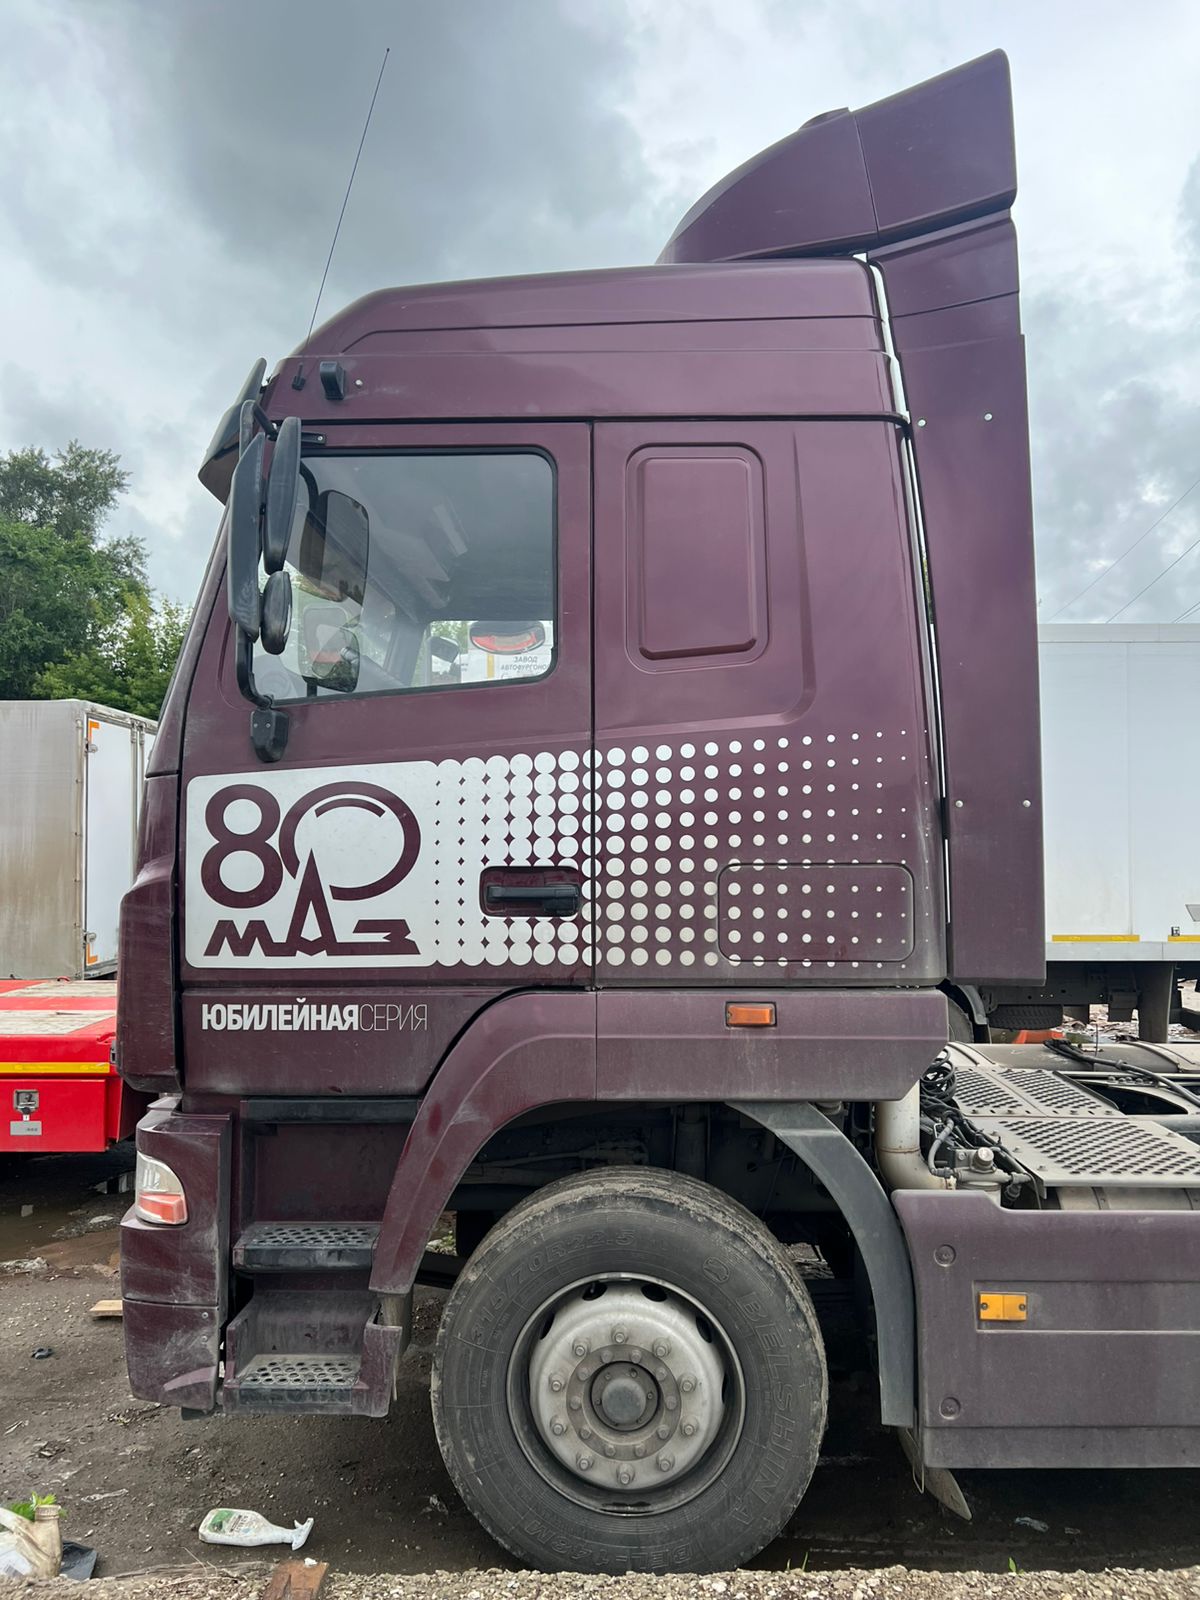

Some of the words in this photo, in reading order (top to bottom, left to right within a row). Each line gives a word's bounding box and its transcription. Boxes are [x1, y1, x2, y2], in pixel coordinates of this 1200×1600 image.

[501, 664, 548, 673] АВТОФУРГОНО
[513, 656, 538, 664] ЗАВОД
[203, 848, 421, 957] МАЗ
[731, 1291, 798, 1526] BELSHINA
